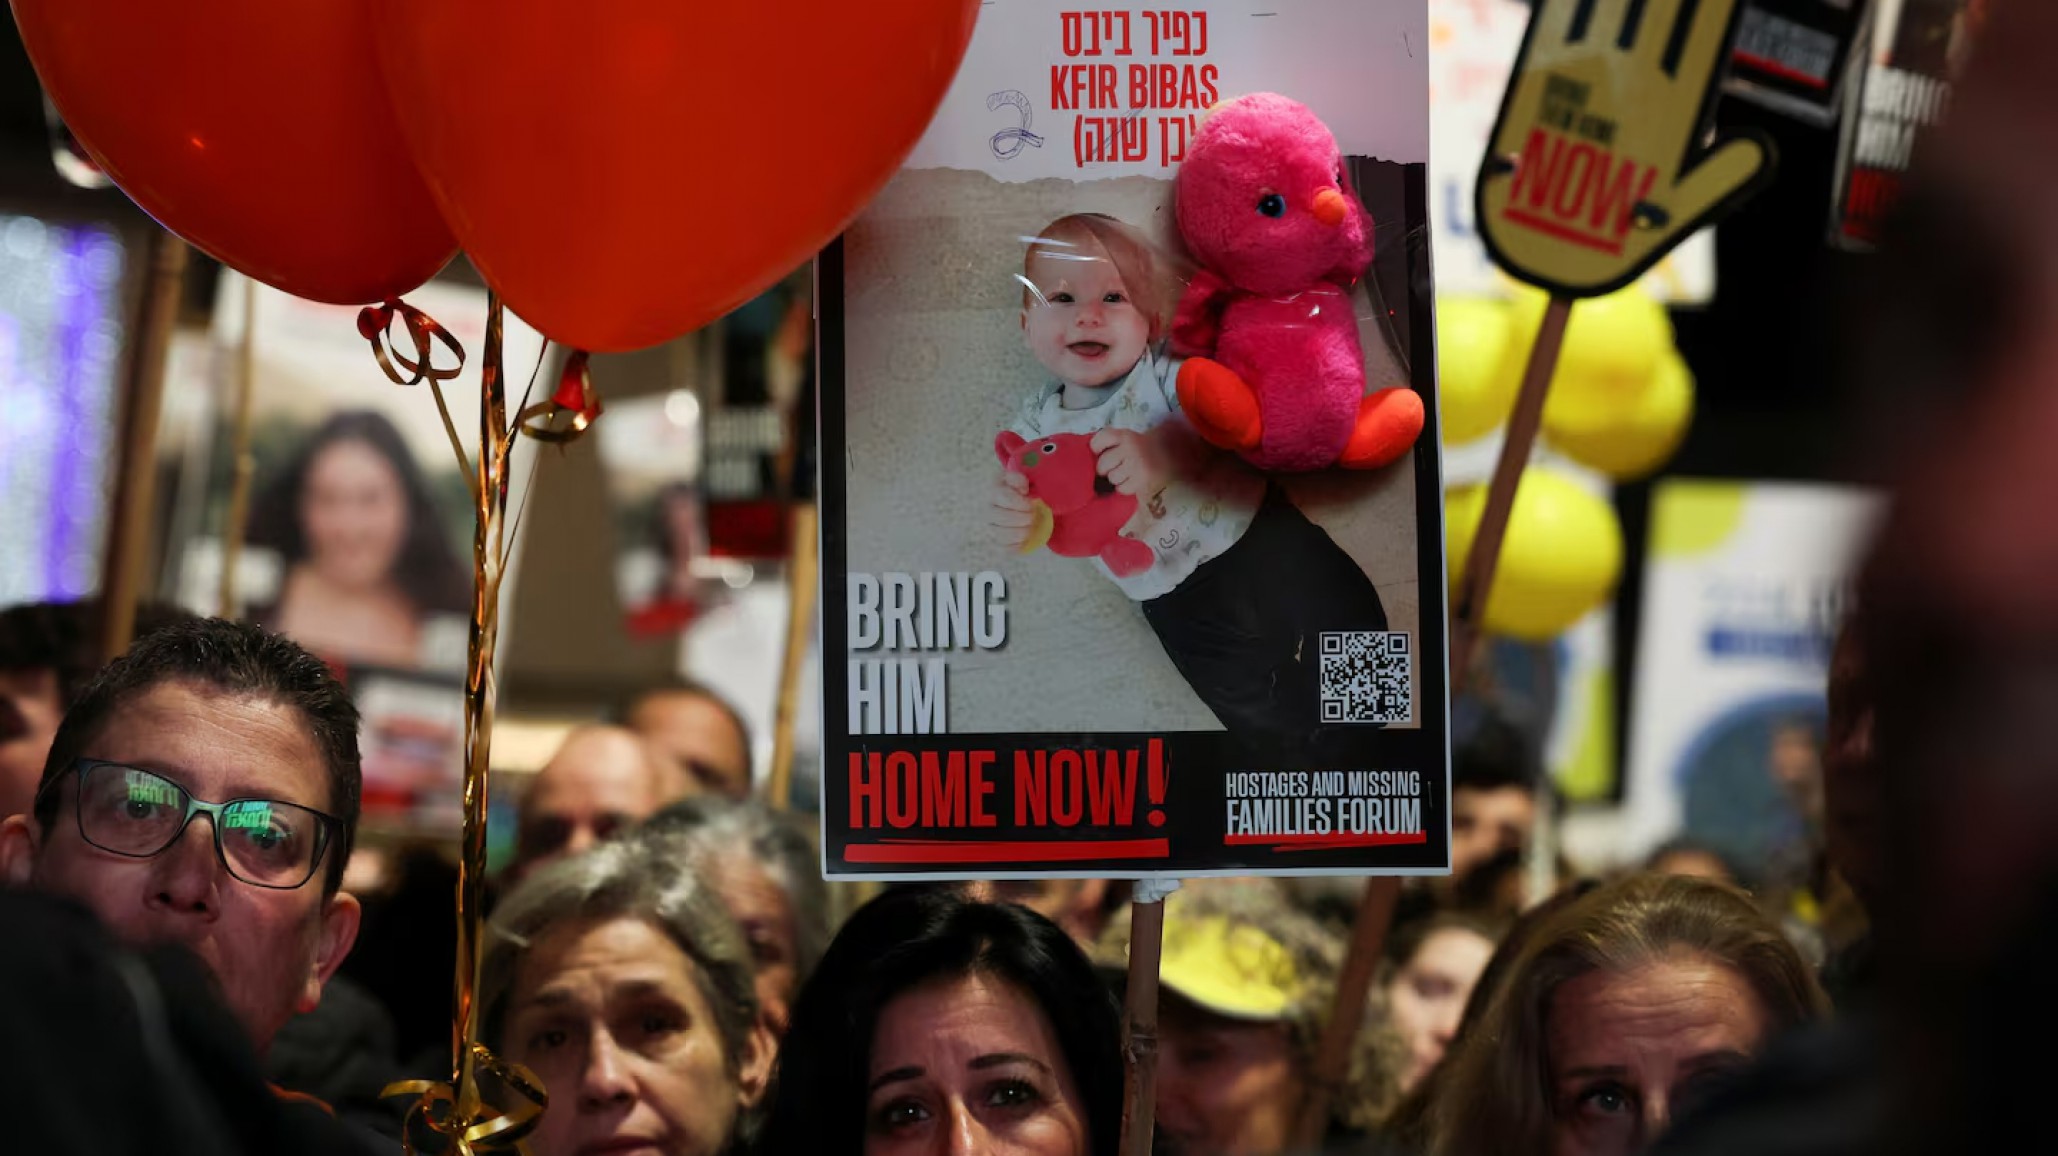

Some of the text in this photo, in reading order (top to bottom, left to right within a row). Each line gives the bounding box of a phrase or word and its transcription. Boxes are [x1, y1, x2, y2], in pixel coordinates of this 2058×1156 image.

[1060, 10, 1208, 57] כפיר ביבס
[1051, 63, 1219, 110] KFIR BIBAS
[1508, 126, 1660, 240] NOW
[847, 571, 1007, 650] BRING
[848, 657, 947, 735] HIM
[848, 737, 1169, 829] HOME NOW!
[1225, 770, 1421, 798] HOSTAGES AND MISSING
[1226, 797, 1422, 836] FAMILIES FORUM
